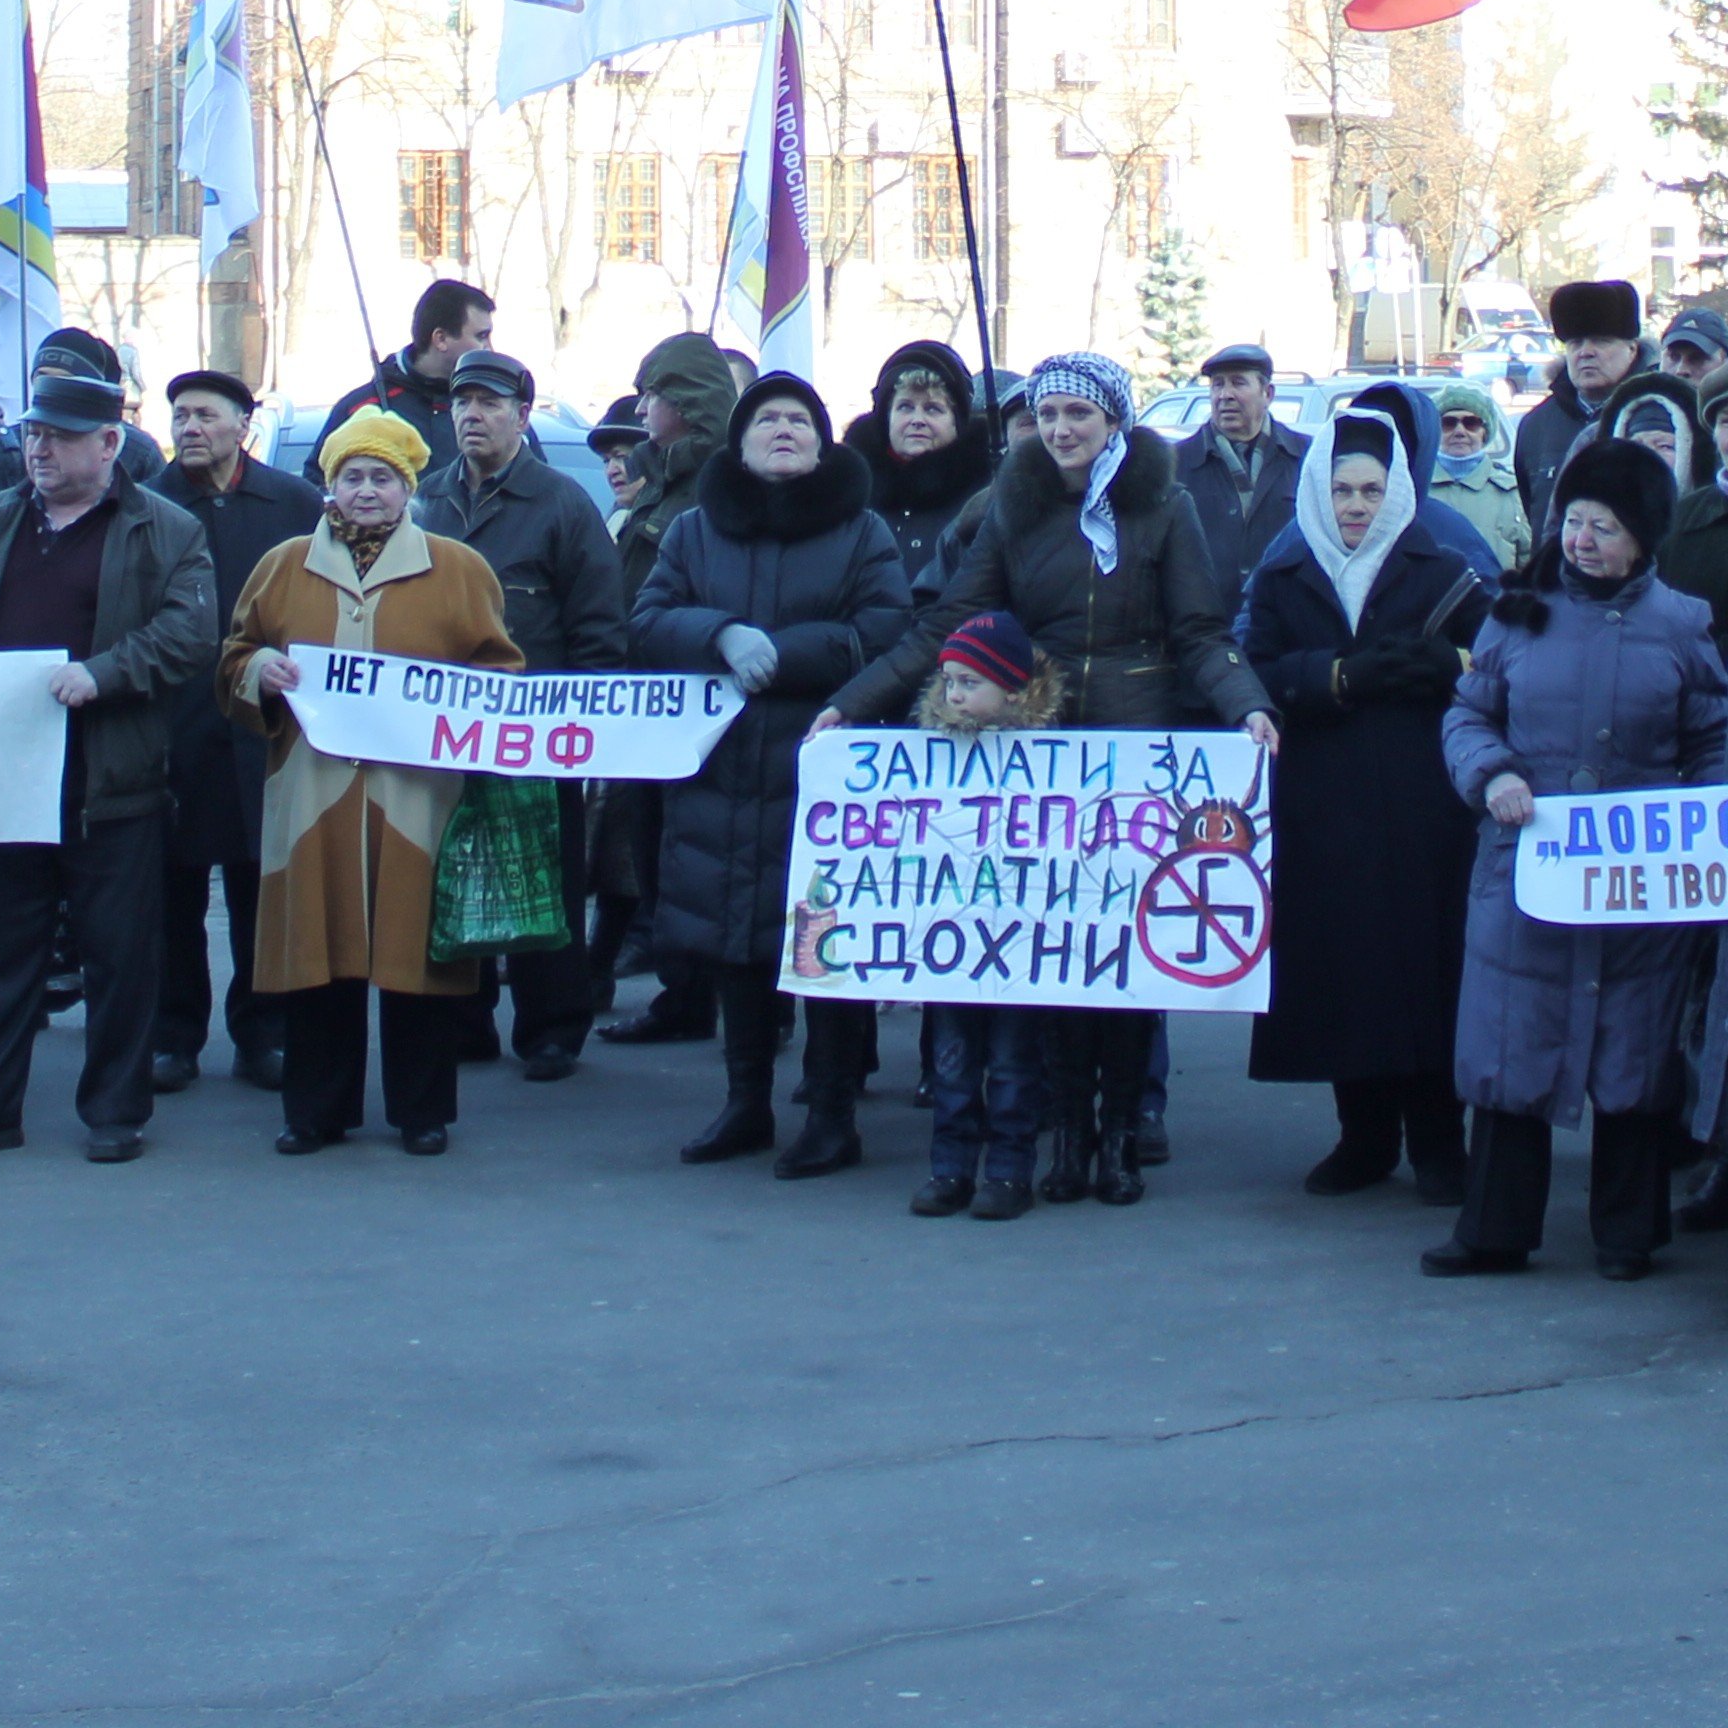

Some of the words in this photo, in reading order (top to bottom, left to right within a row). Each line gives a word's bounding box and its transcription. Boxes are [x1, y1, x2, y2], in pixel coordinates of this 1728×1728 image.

[325, 653, 385, 696] НЕТ
[402, 664, 686, 718] СОТРУДНИЧЕСТВУ
[703, 678, 724, 717] С
[430, 714, 595, 770] МВФ
[845, 737, 1117, 793] ЗАПЛАТИ
[1144, 735, 1215, 796] ЗА
[805, 797, 942, 849] СВЕТ
[960, 795, 1169, 858] ТЕПЛО
[814, 855, 1080, 913] ЗАПЛАТИ
[1101, 866, 1137, 919] И
[1583, 864, 1648, 912] ГДЕ
[815, 918, 1133, 990] СДОХНИ
